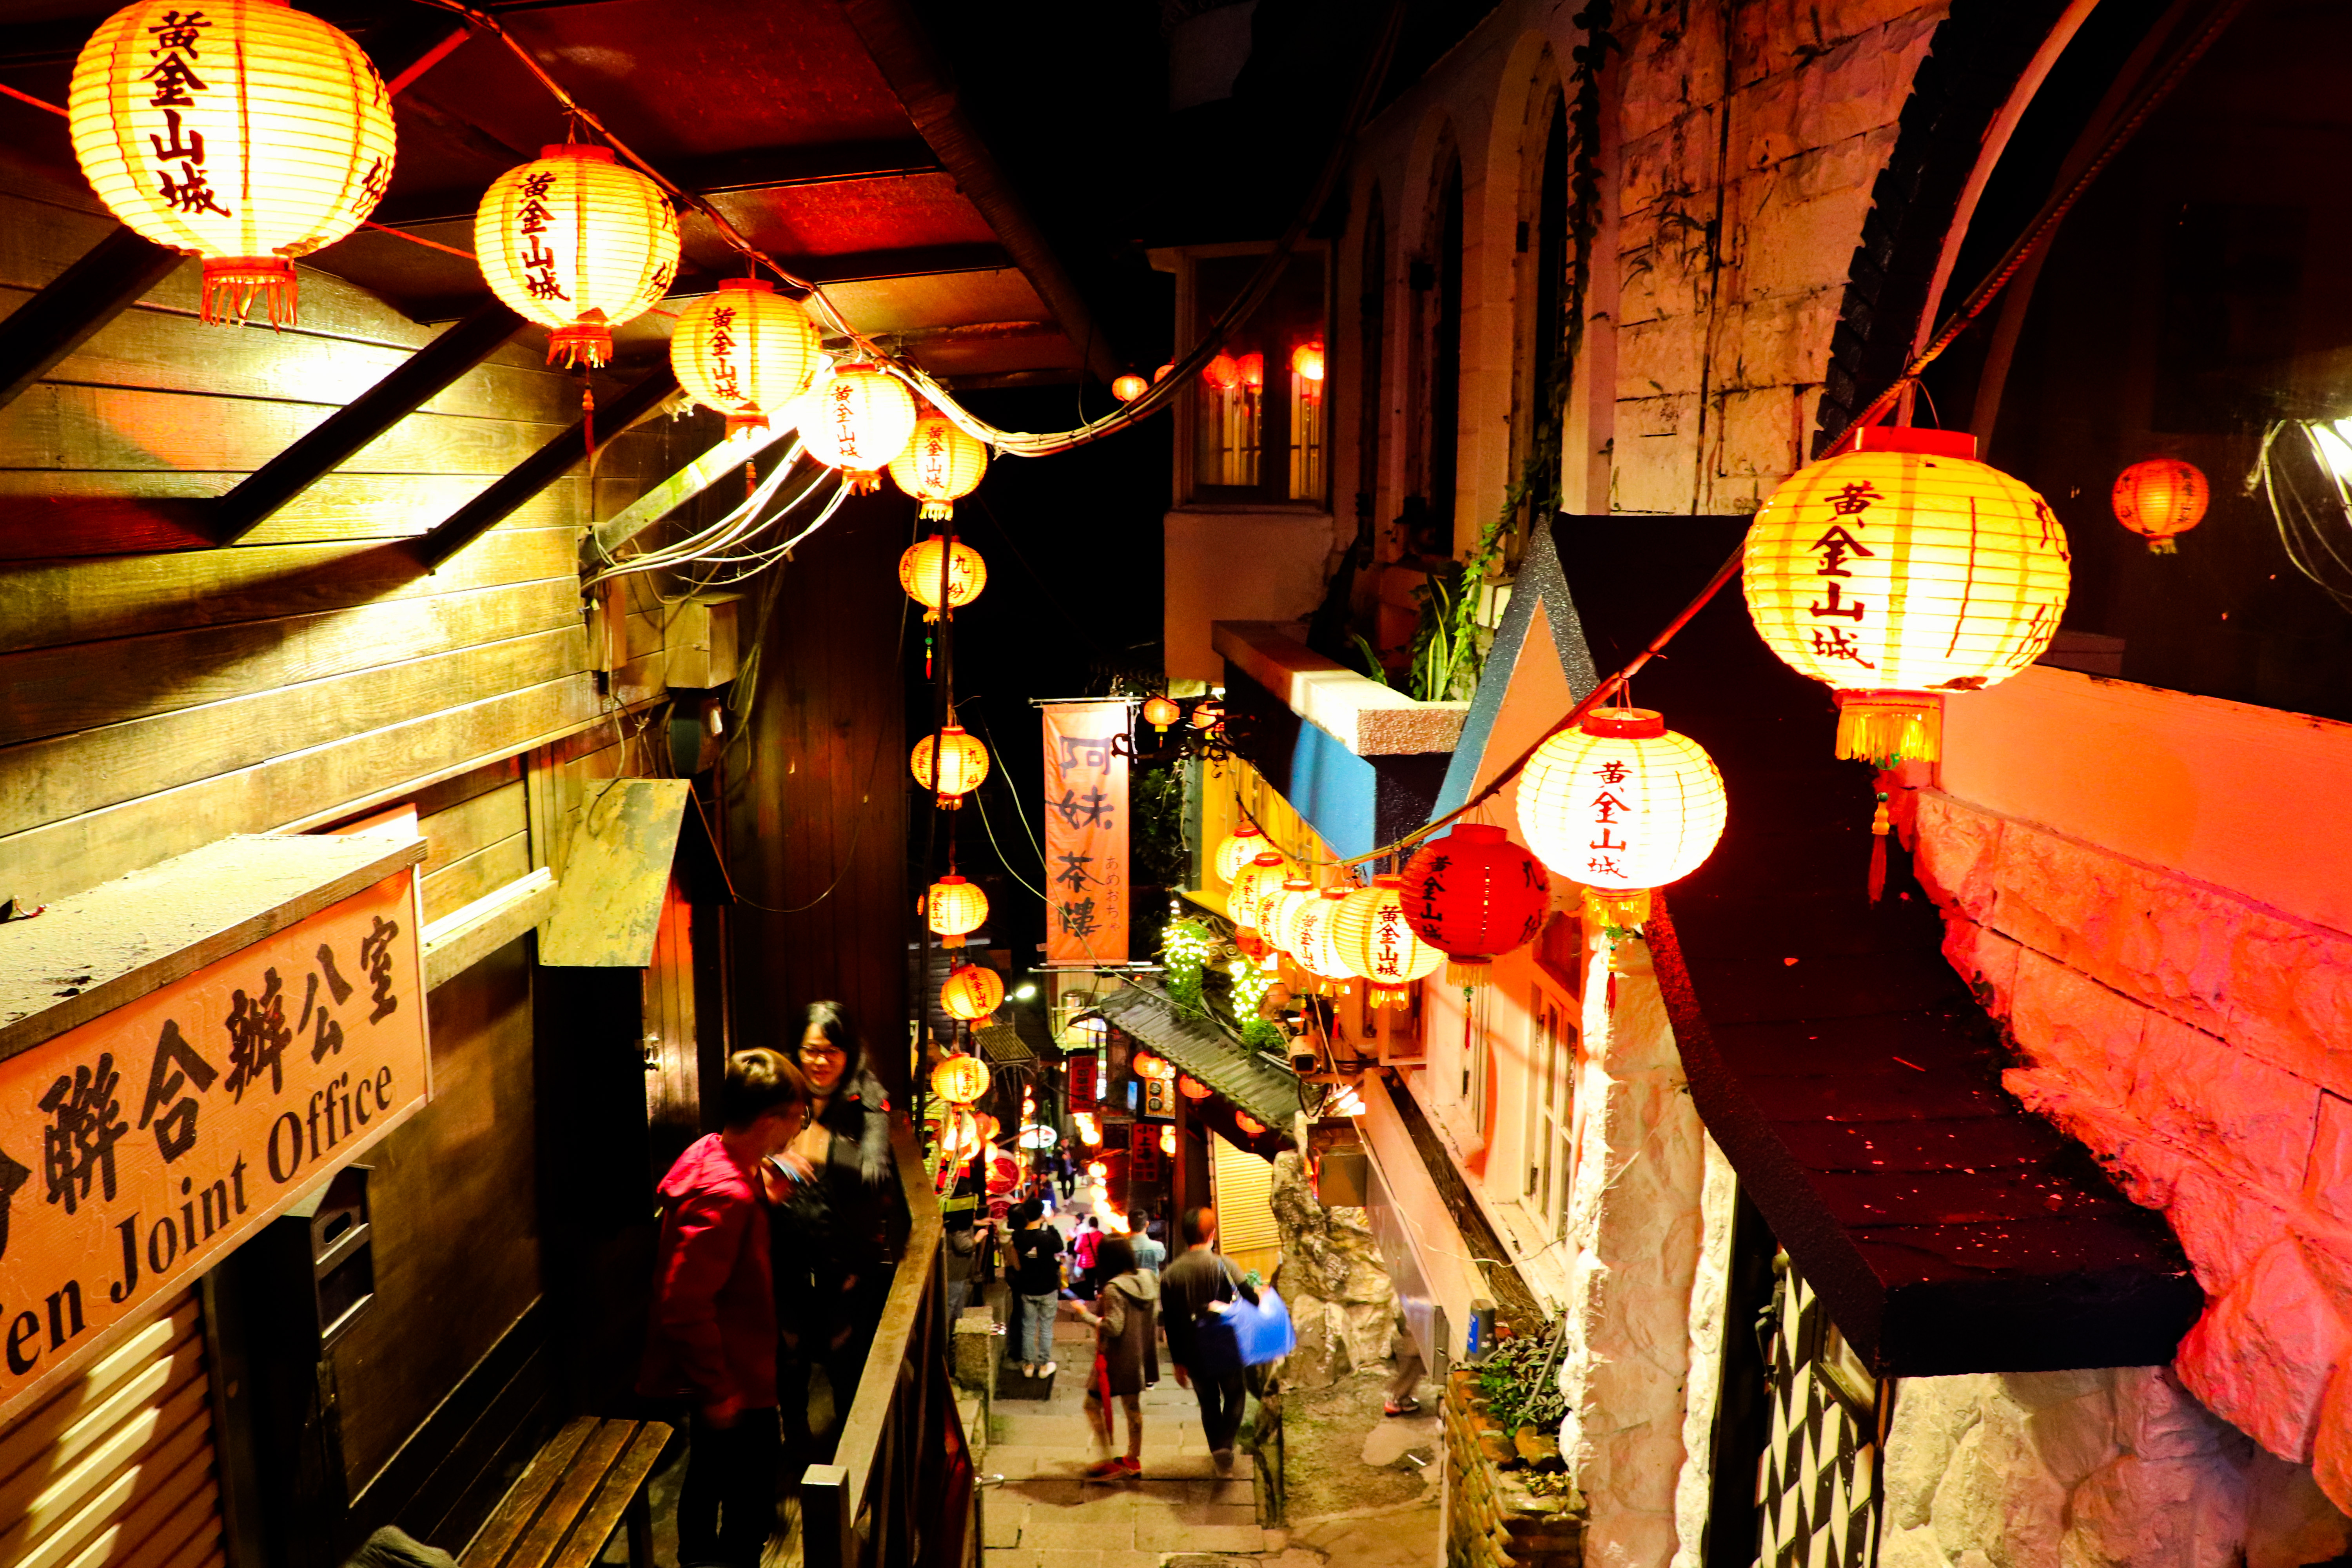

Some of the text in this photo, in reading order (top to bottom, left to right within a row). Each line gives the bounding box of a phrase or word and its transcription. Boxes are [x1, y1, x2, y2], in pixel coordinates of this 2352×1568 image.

[1105, 856, 1121, 933] あめおちゃ
[0, 1064, 393, 1376] en Joint Office
